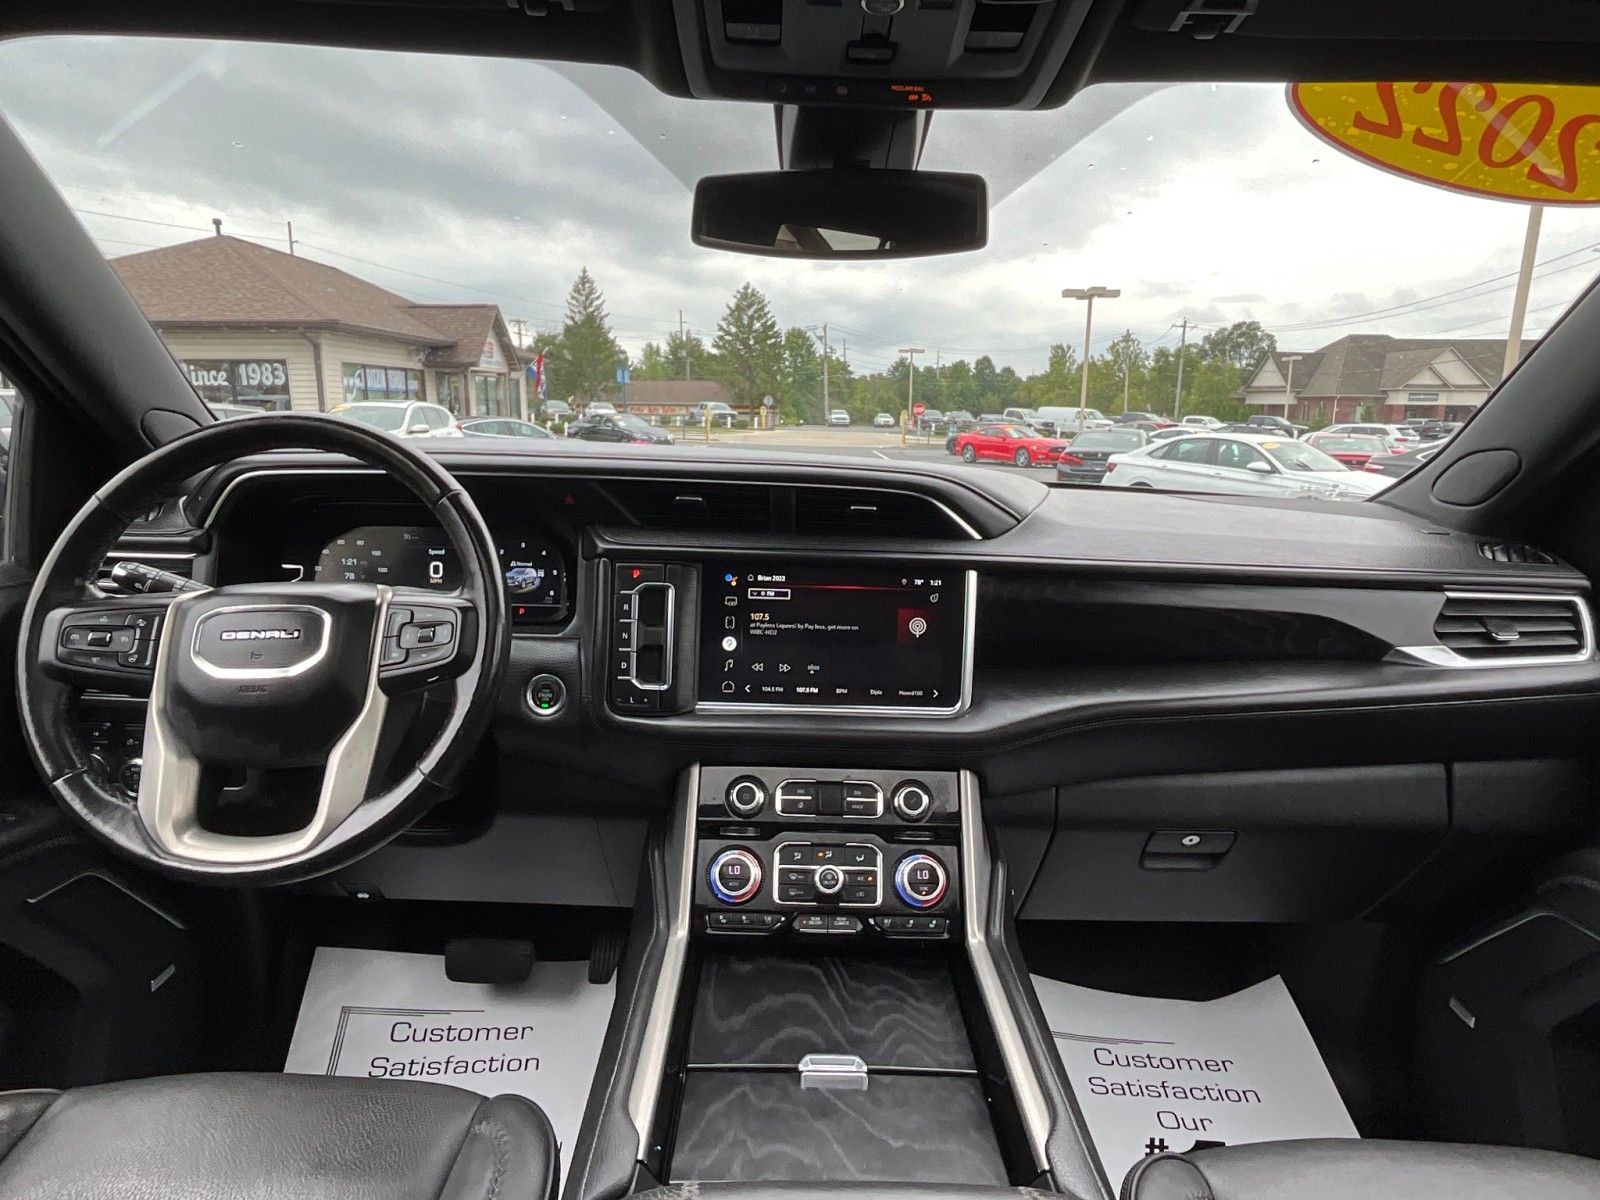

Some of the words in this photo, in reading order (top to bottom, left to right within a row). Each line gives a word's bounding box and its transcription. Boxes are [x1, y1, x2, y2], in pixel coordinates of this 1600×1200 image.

[238, 362, 286, 386] 1983
[428, 548, 445, 556] Speed
[344, 572, 355, 580] 78
[429, 561, 444, 578] 0
[632, 569, 640, 578] P
[750, 613, 770, 621] 107.5
[221, 630, 300, 640] DENALI
[728, 865, 741, 875] LO
[917, 870, 929, 880] LO
[389, 1021, 534, 1043] Customer
[368, 1053, 540, 1078] Satisfaction
[1093, 1047, 1234, 1073] Customer
[1088, 1076, 1262, 1104] Satisfaction
[1157, 1110, 1213, 1132] Our
